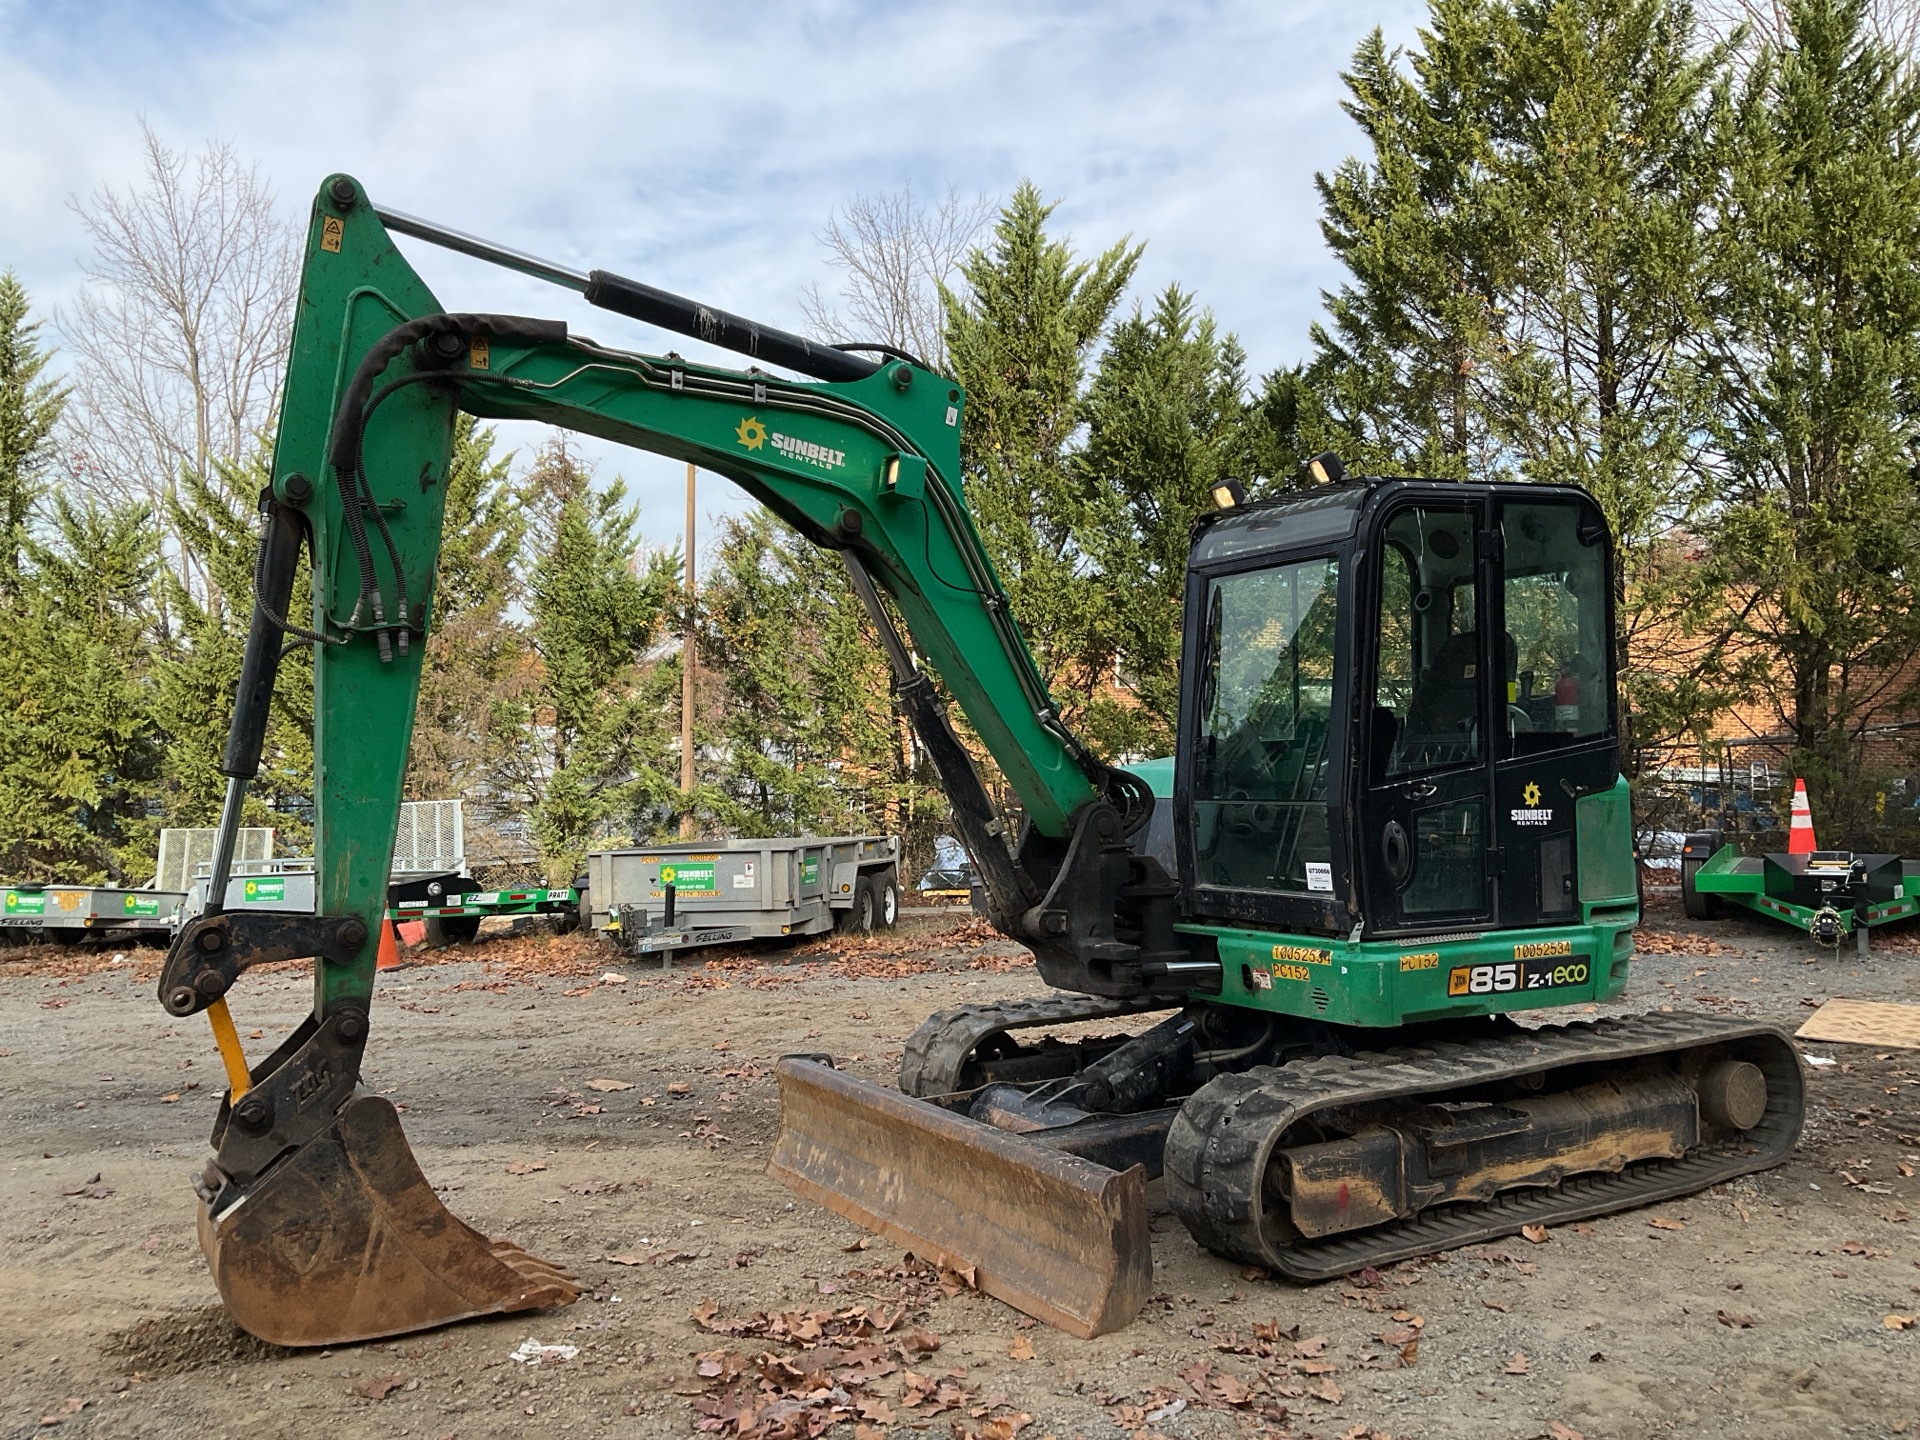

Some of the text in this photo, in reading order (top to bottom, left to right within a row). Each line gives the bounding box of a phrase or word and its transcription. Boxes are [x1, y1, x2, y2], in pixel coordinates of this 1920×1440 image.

[771, 432, 845, 467] SUNBELT
[780, 449, 832, 470] RENTALS
[1511, 809, 1552, 821] SUNBELT
[678, 870, 713, 878] SUNBELT
[0, 918, 44, 926] FELLING
[695, 932, 733, 942] FELLING
[1516, 941, 1571, 958] 10052534
[1401, 955, 1437, 970] PC152
[1273, 964, 1309, 981] PC152
[1469, 964, 1516, 993] 85
